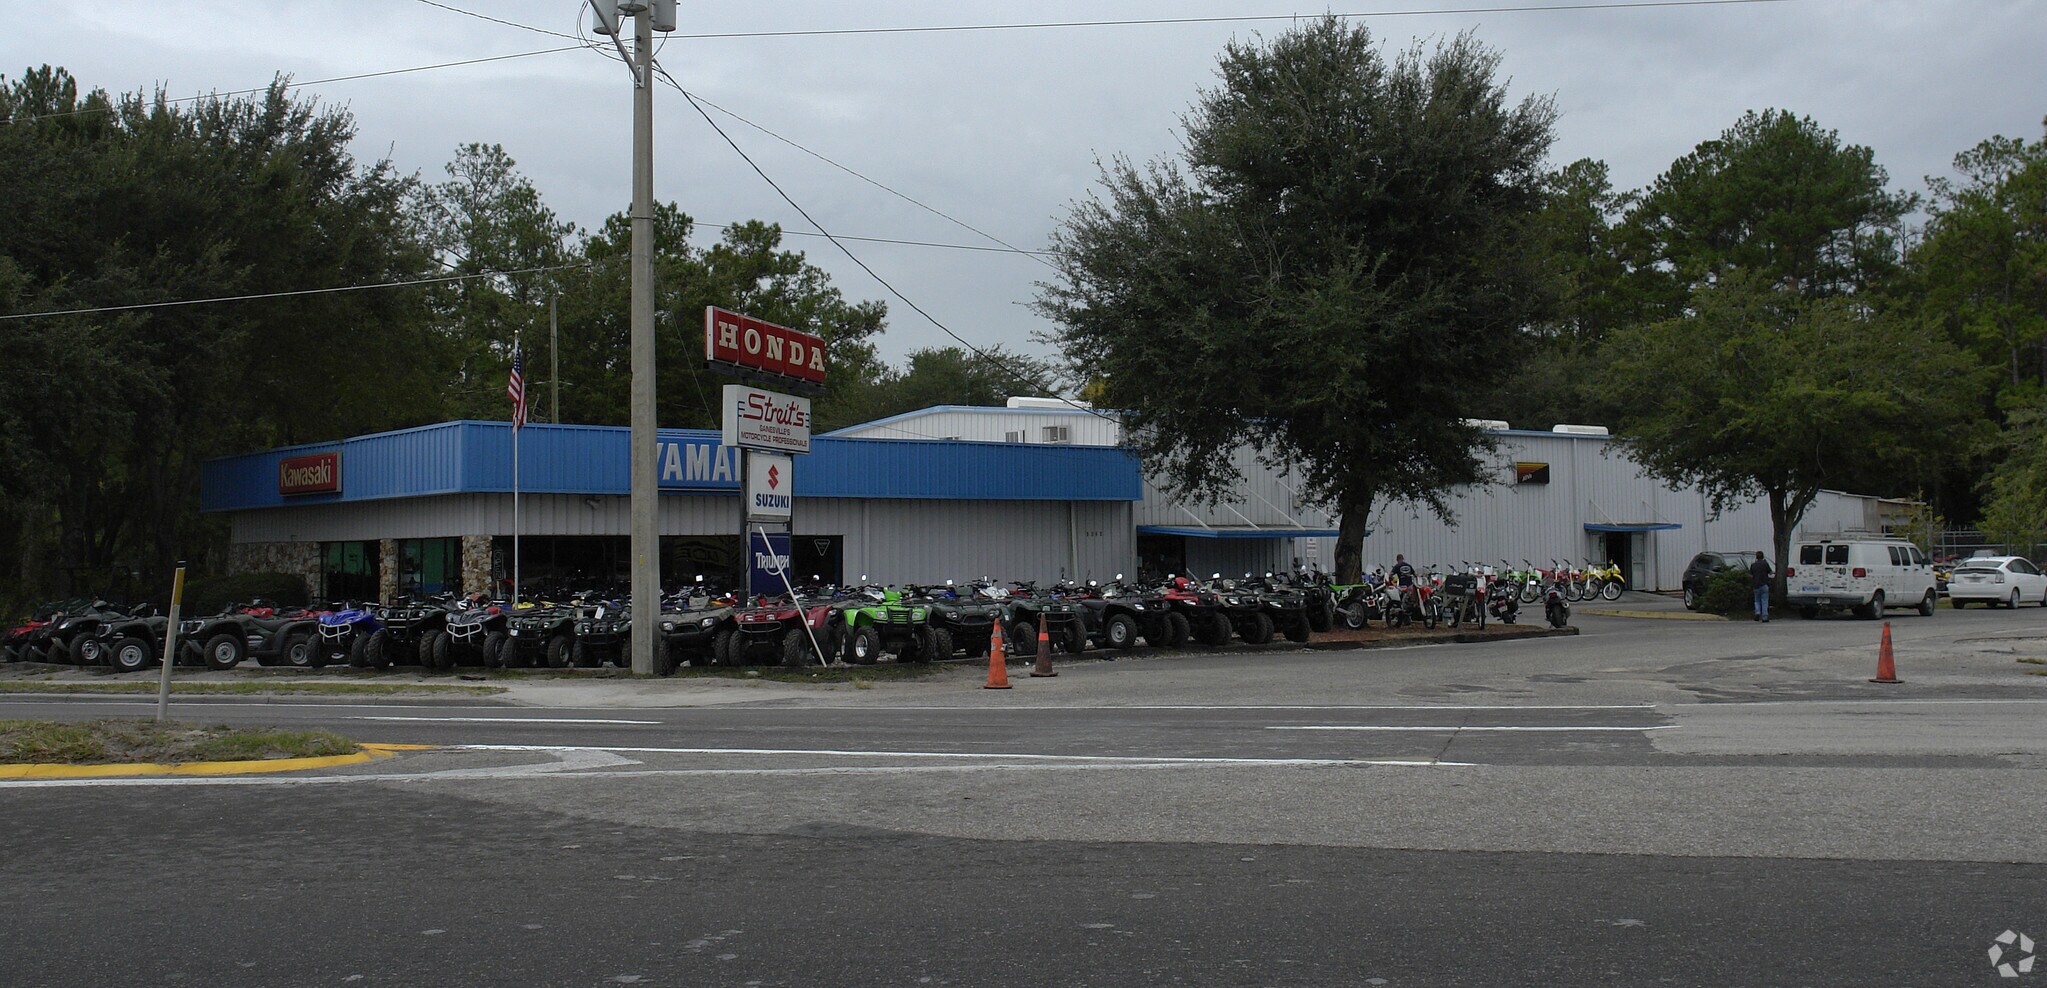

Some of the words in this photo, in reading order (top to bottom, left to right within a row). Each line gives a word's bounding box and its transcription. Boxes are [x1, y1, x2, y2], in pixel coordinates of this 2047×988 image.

[718, 321, 825, 372] HONDA
[743, 393, 805, 427] Streit's
[740, 431, 772, 443] MOTORCYCLE
[772, 435, 808, 448] PROFESSIONALS
[280, 458, 332, 488] Kawasaki
[755, 493, 790, 509] SUZUKI
